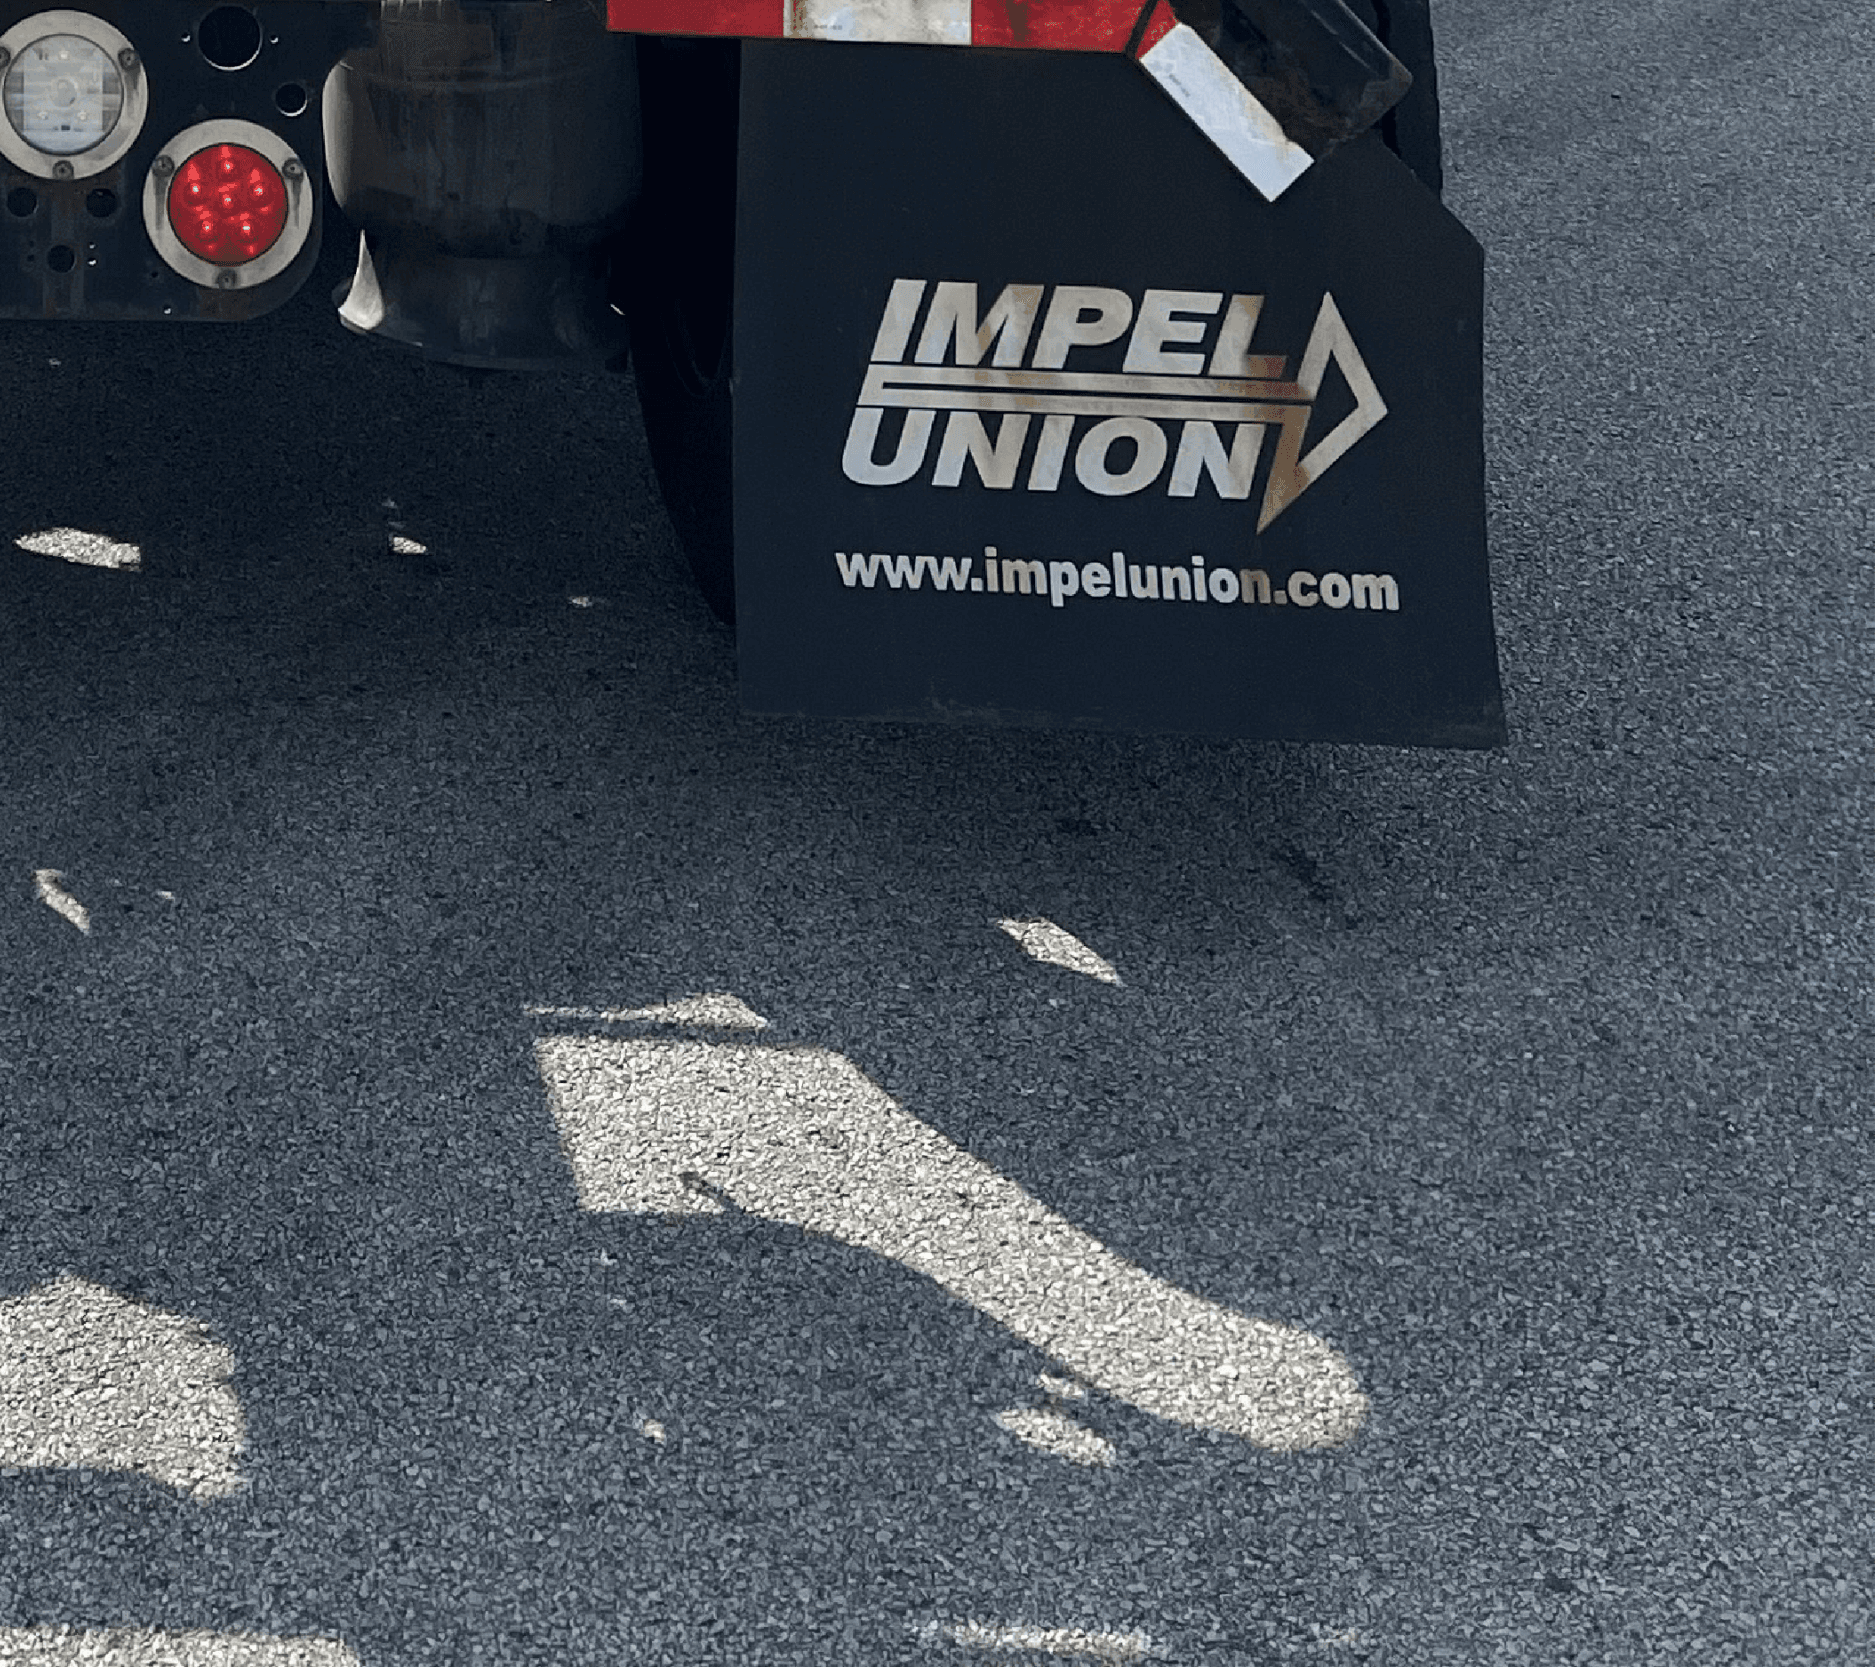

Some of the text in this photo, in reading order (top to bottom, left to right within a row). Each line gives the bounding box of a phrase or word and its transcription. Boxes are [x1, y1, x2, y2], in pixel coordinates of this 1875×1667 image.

[871, 278, 1287, 378] IMPEL
[842, 407, 1266, 500] UNION
[835, 545, 1400, 611] www.impelunion.com
